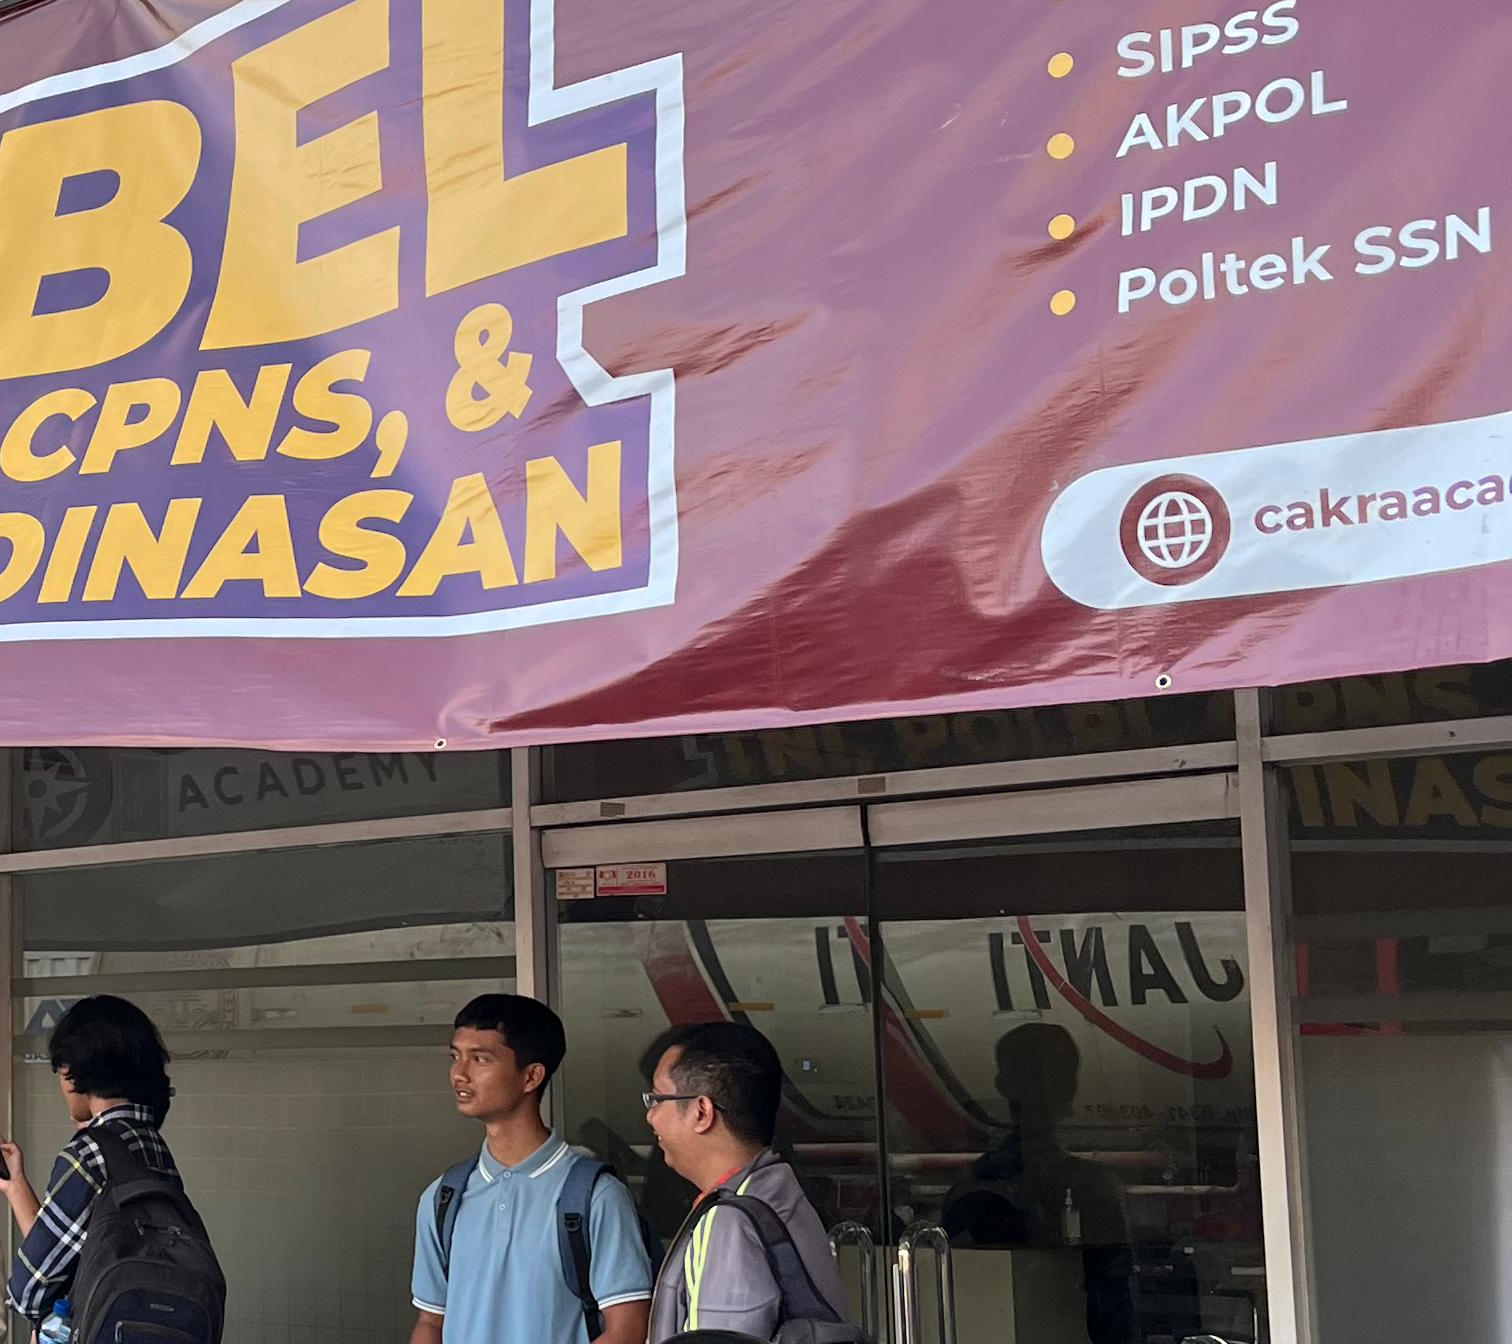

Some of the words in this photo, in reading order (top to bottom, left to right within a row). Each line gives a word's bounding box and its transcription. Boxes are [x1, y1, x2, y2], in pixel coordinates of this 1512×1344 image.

[1115, 69, 1349, 159] AKPOL
[1120, 160, 1279, 237] IPDN
[1117, 236, 1335, 314] Poltek
[1353, 205, 1492, 276] SSN
[444, 304, 533, 433] &
[1254, 473, 1512, 535] cakraaca
[178, 752, 439, 813] ACADEMY
